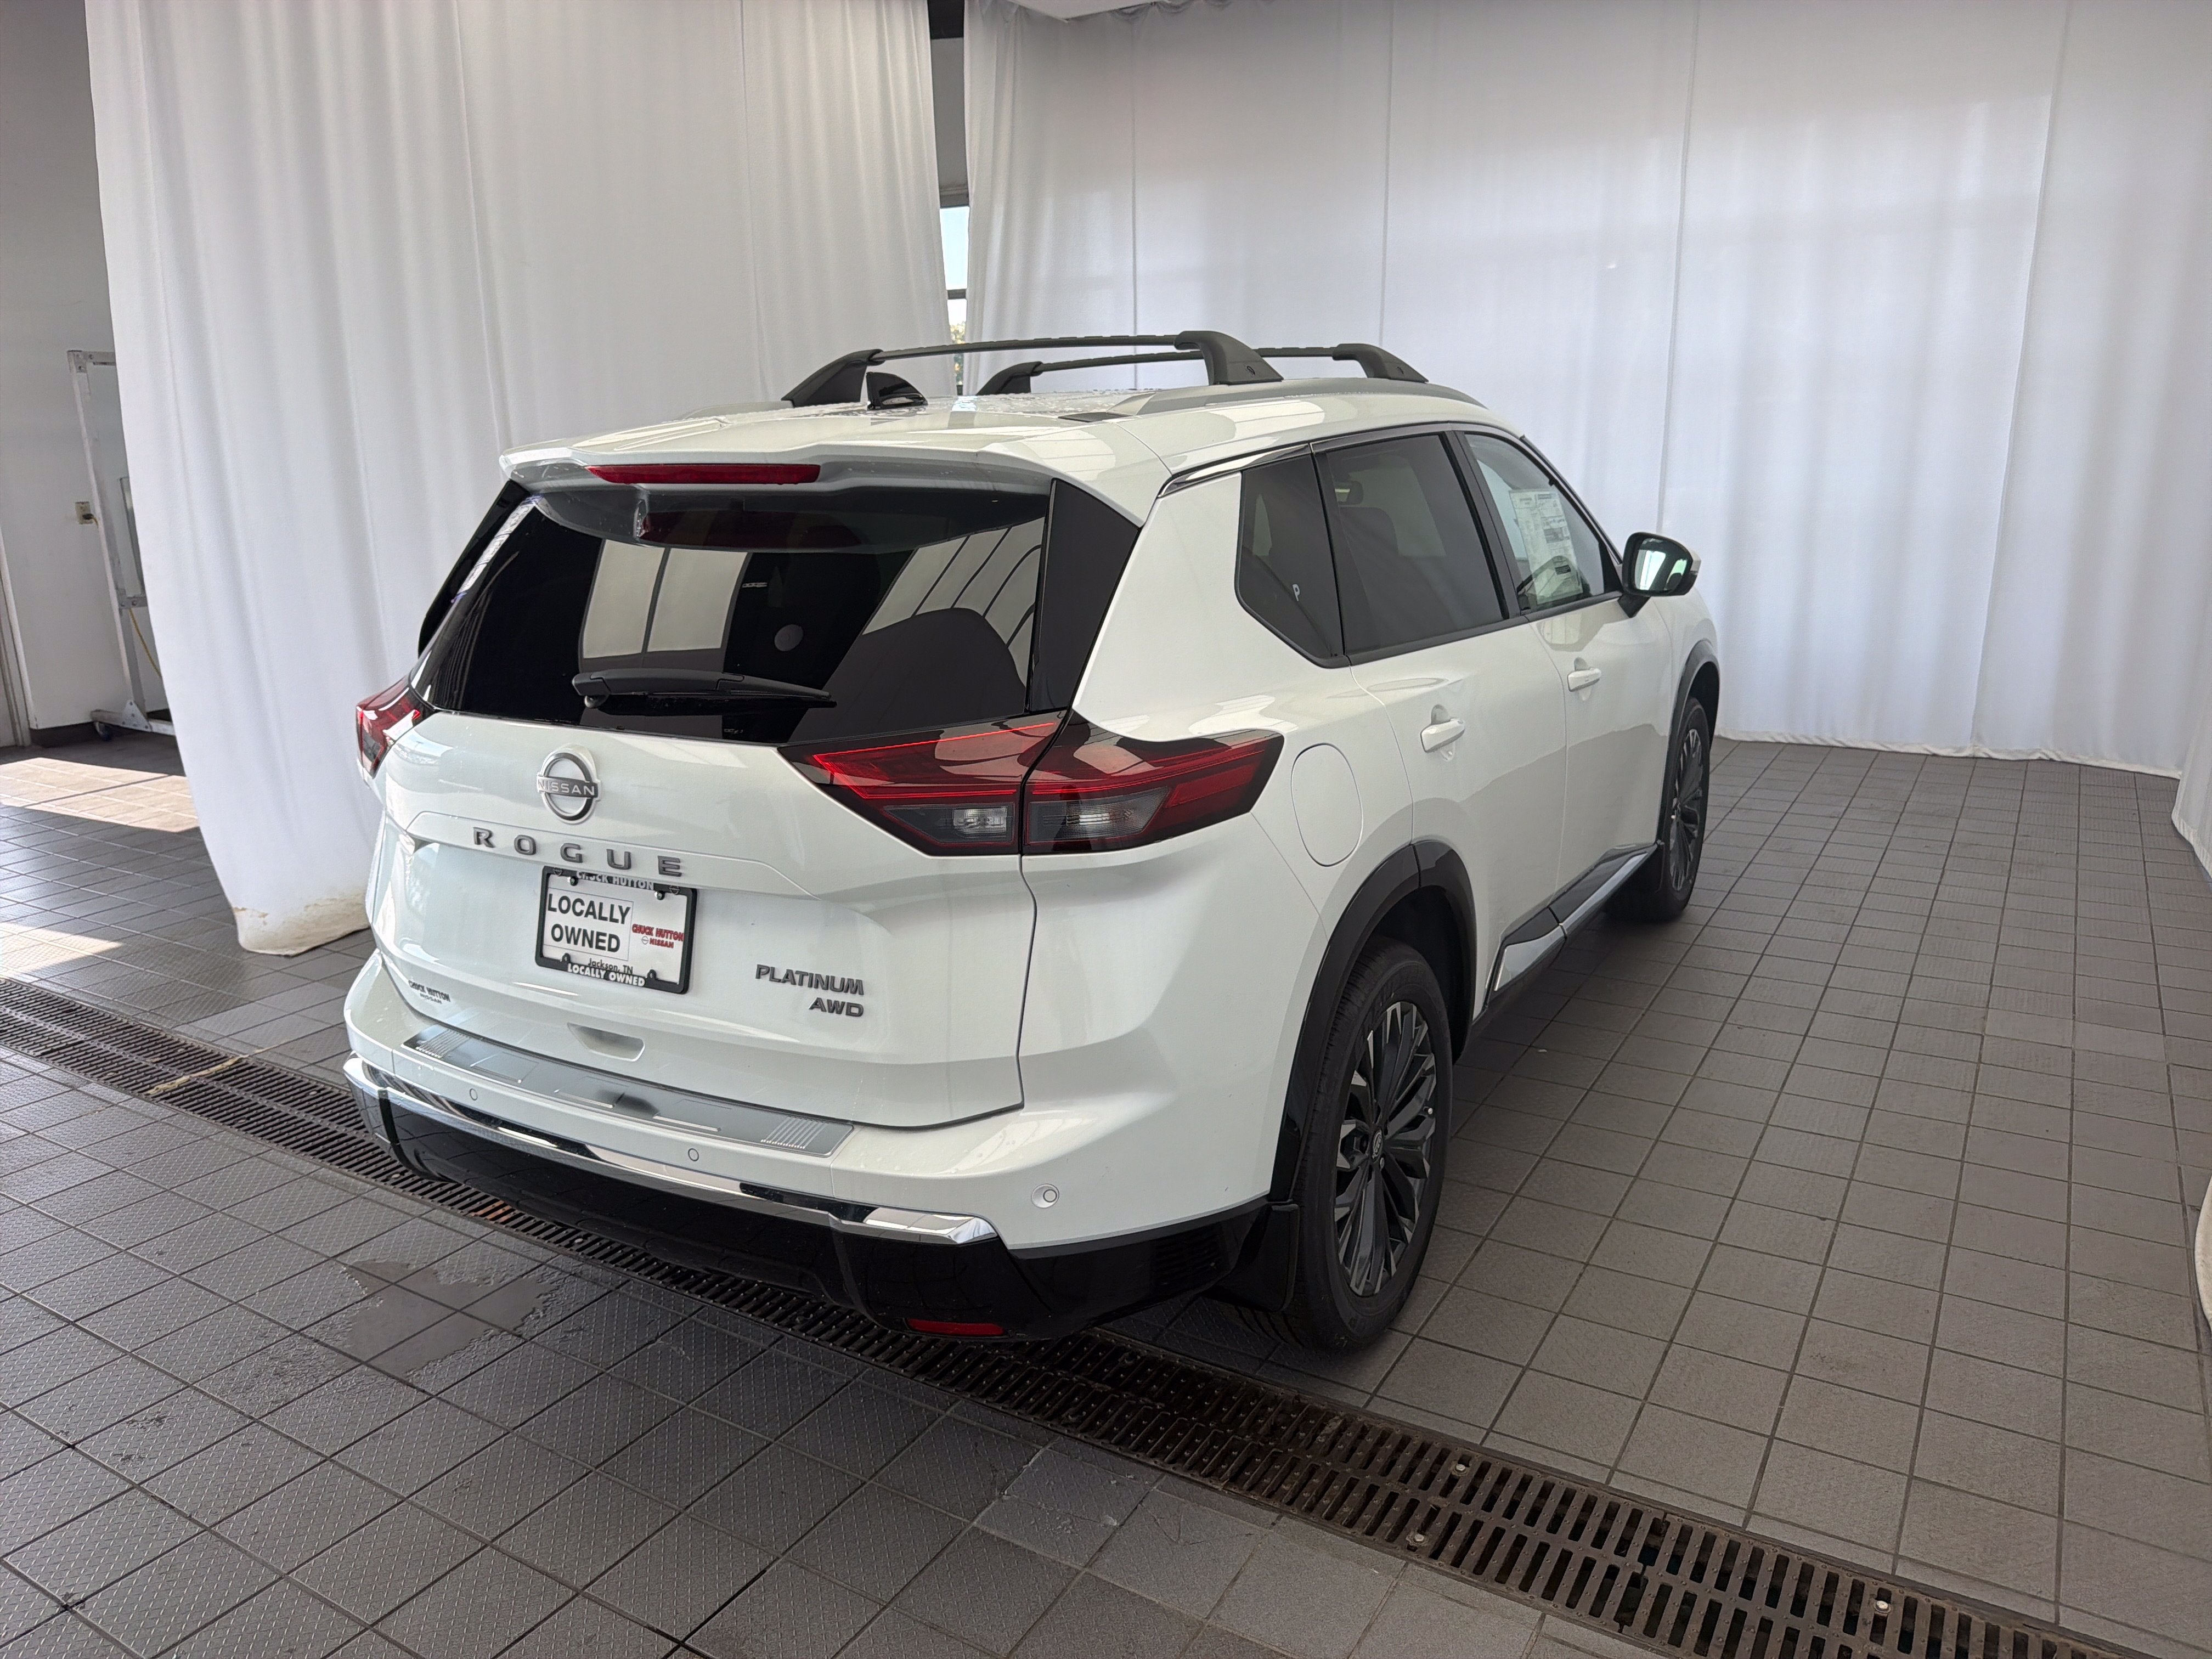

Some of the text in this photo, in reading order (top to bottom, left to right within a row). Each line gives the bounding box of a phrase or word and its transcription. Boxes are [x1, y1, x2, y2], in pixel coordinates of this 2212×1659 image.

[538, 779, 595, 796] NISSAN
[473, 827, 682, 877] ROGUE
[612, 876, 654, 890] HUTTON
[548, 893, 631, 925] LOCALLY
[551, 923, 620, 952] OWNED
[632, 924, 685, 942] CHUCK HUTTON
[649, 938, 674, 949] NISSAN
[567, 963, 645, 986] LOCALLY OWNED
[588, 957, 633, 974] Jackson, TN
[755, 964, 865, 996] PLATINUM
[408, 980, 451, 1002] CHUCK HUTTON
[808, 997, 865, 1018] AWD
